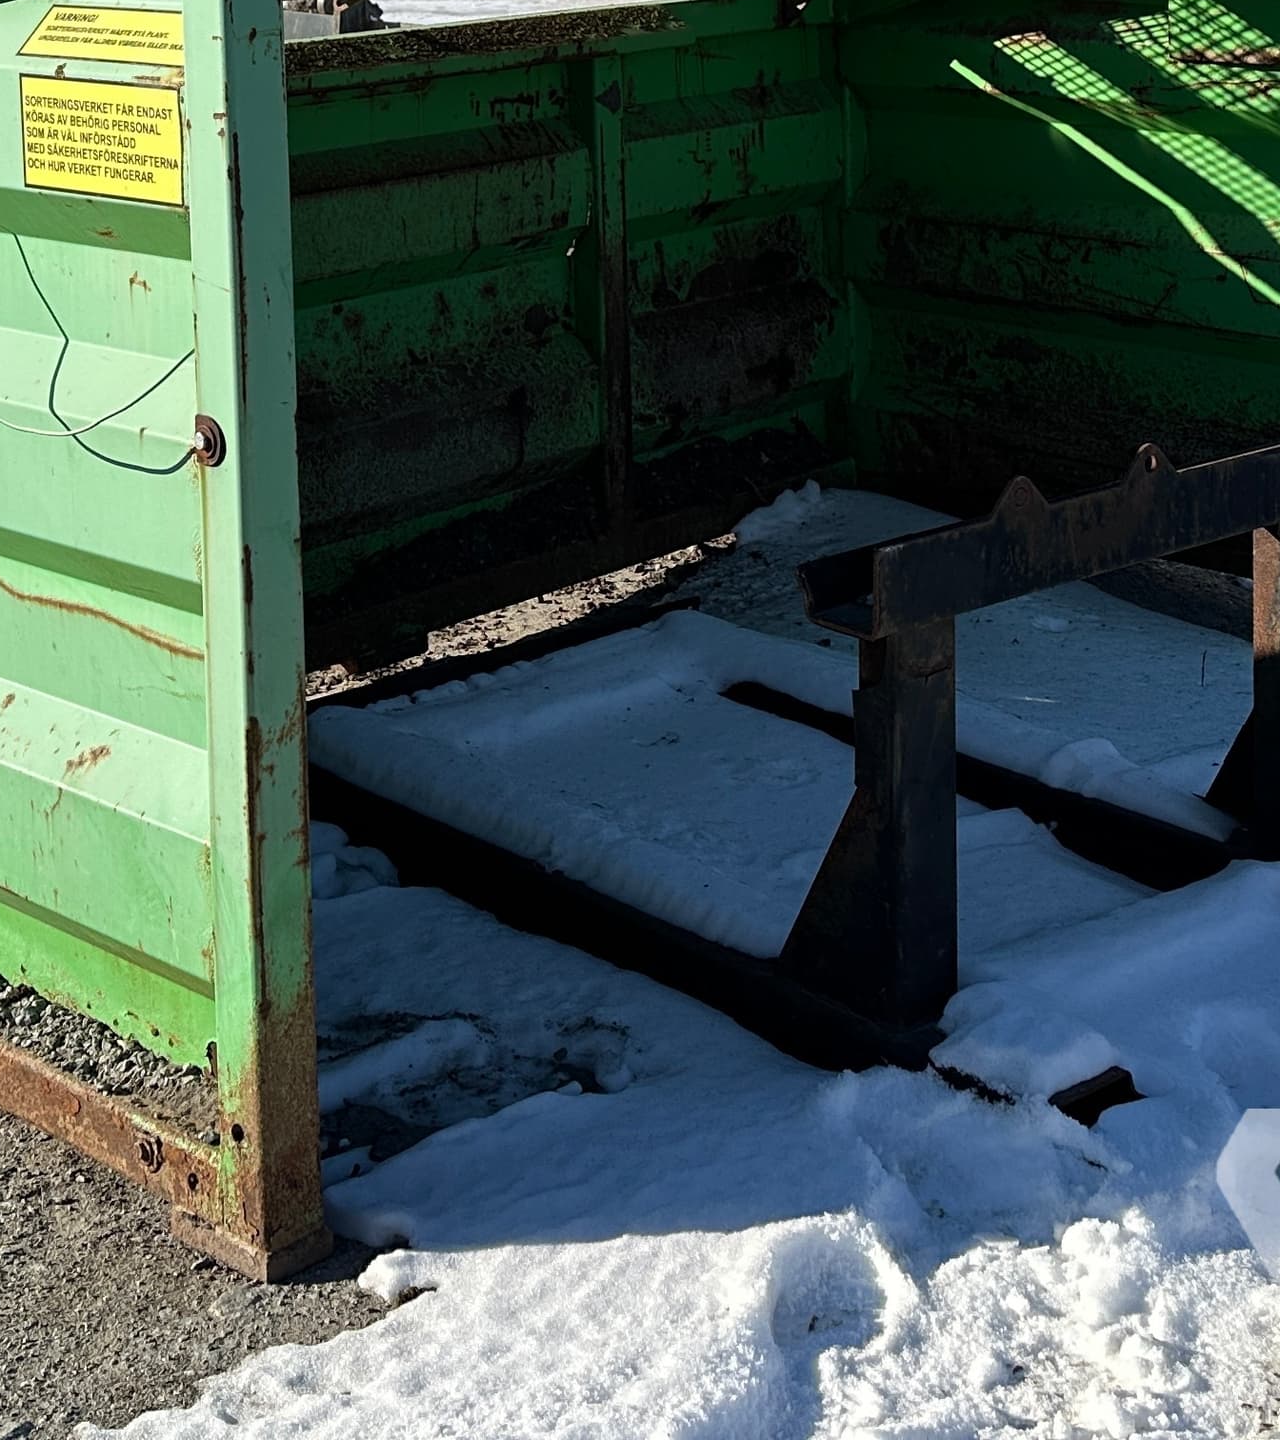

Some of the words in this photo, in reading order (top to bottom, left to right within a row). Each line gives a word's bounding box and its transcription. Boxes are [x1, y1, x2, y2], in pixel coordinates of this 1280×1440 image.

[54, 12, 100, 23] VARNING!
[25, 95, 114, 115] SORTERINGSVERKET
[116, 103, 134, 117] FÅR
[136, 106, 173, 121] ENDAST
[25, 111, 55, 125] KÖRAS
[57, 115, 68, 126] AV
[70, 115, 110, 130] BEHÖRIG
[112, 120, 162, 136] PERSONAL
[26, 126, 45, 139] SOM
[47, 127, 59, 140] ÄR
[61, 129, 78, 143] VÄL
[79, 131, 137, 149] INFÖRSTÅDD
[27, 142, 45, 154] MED
[47, 143, 179, 171] SÄKERHETSFÖRESKRIFTERNA
[27, 157, 46, 170] OCH
[48, 160, 66, 173] HUR
[67, 162, 103, 177] VERKET
[104, 166, 157, 184] FUNGERAR.
